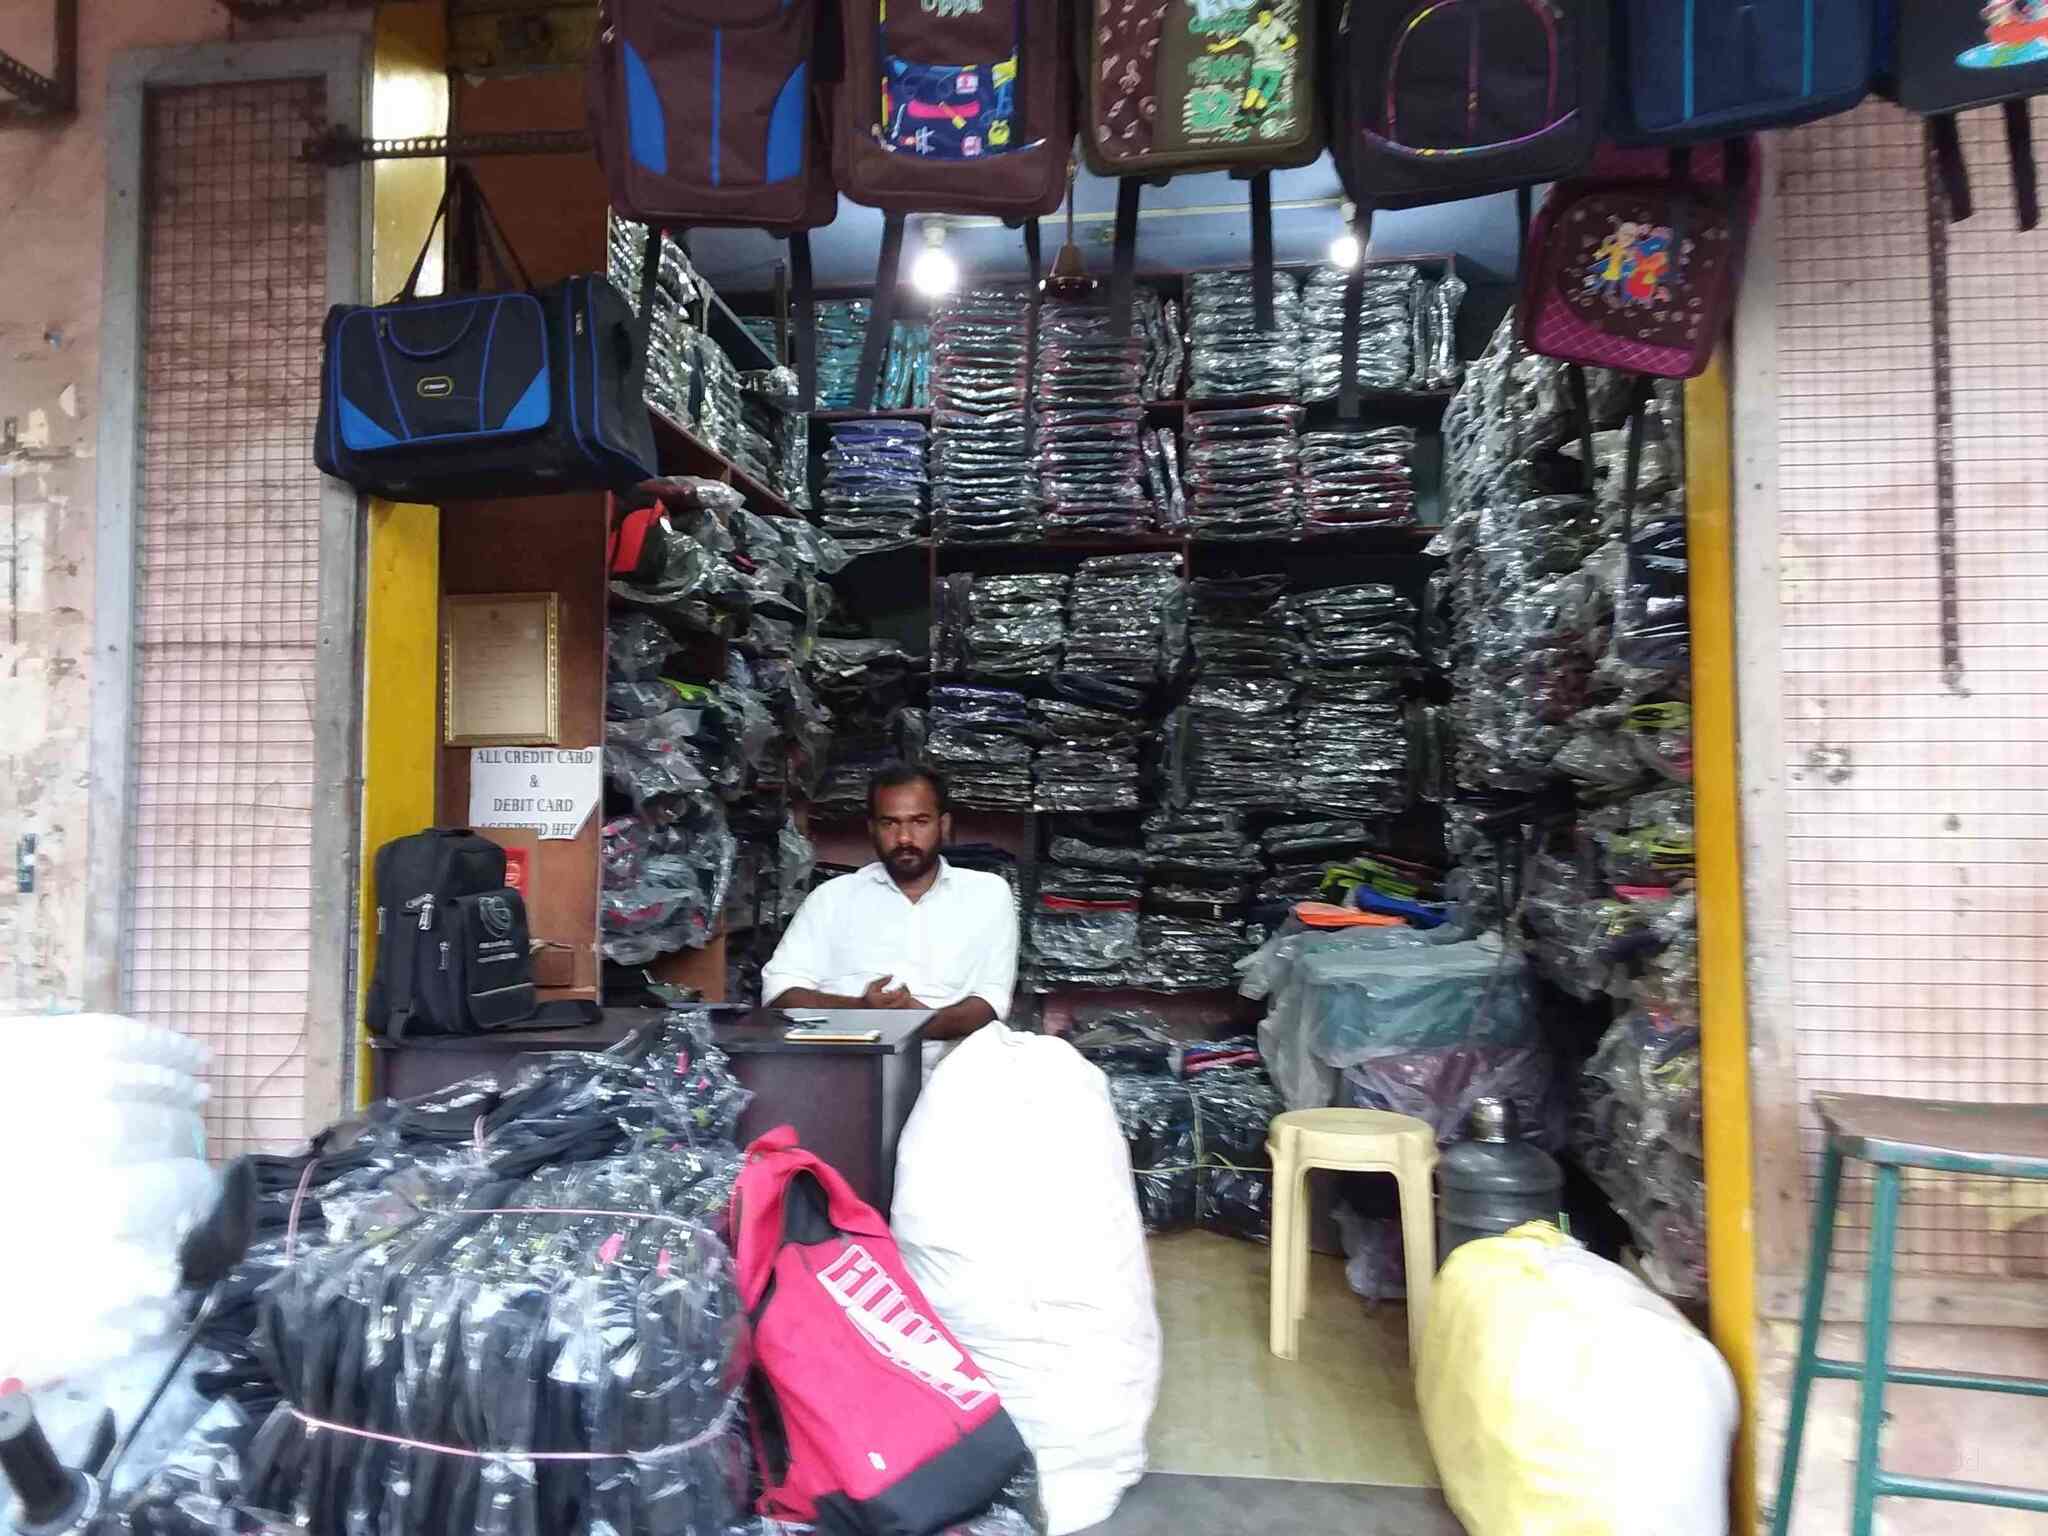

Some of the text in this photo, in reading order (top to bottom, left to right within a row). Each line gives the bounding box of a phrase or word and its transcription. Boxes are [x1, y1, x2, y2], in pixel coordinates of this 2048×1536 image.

[477, 750, 593, 764] ALL CREDIT CARD
[529, 774, 540, 788] &
[493, 798, 574, 812] DEBIT CARD
